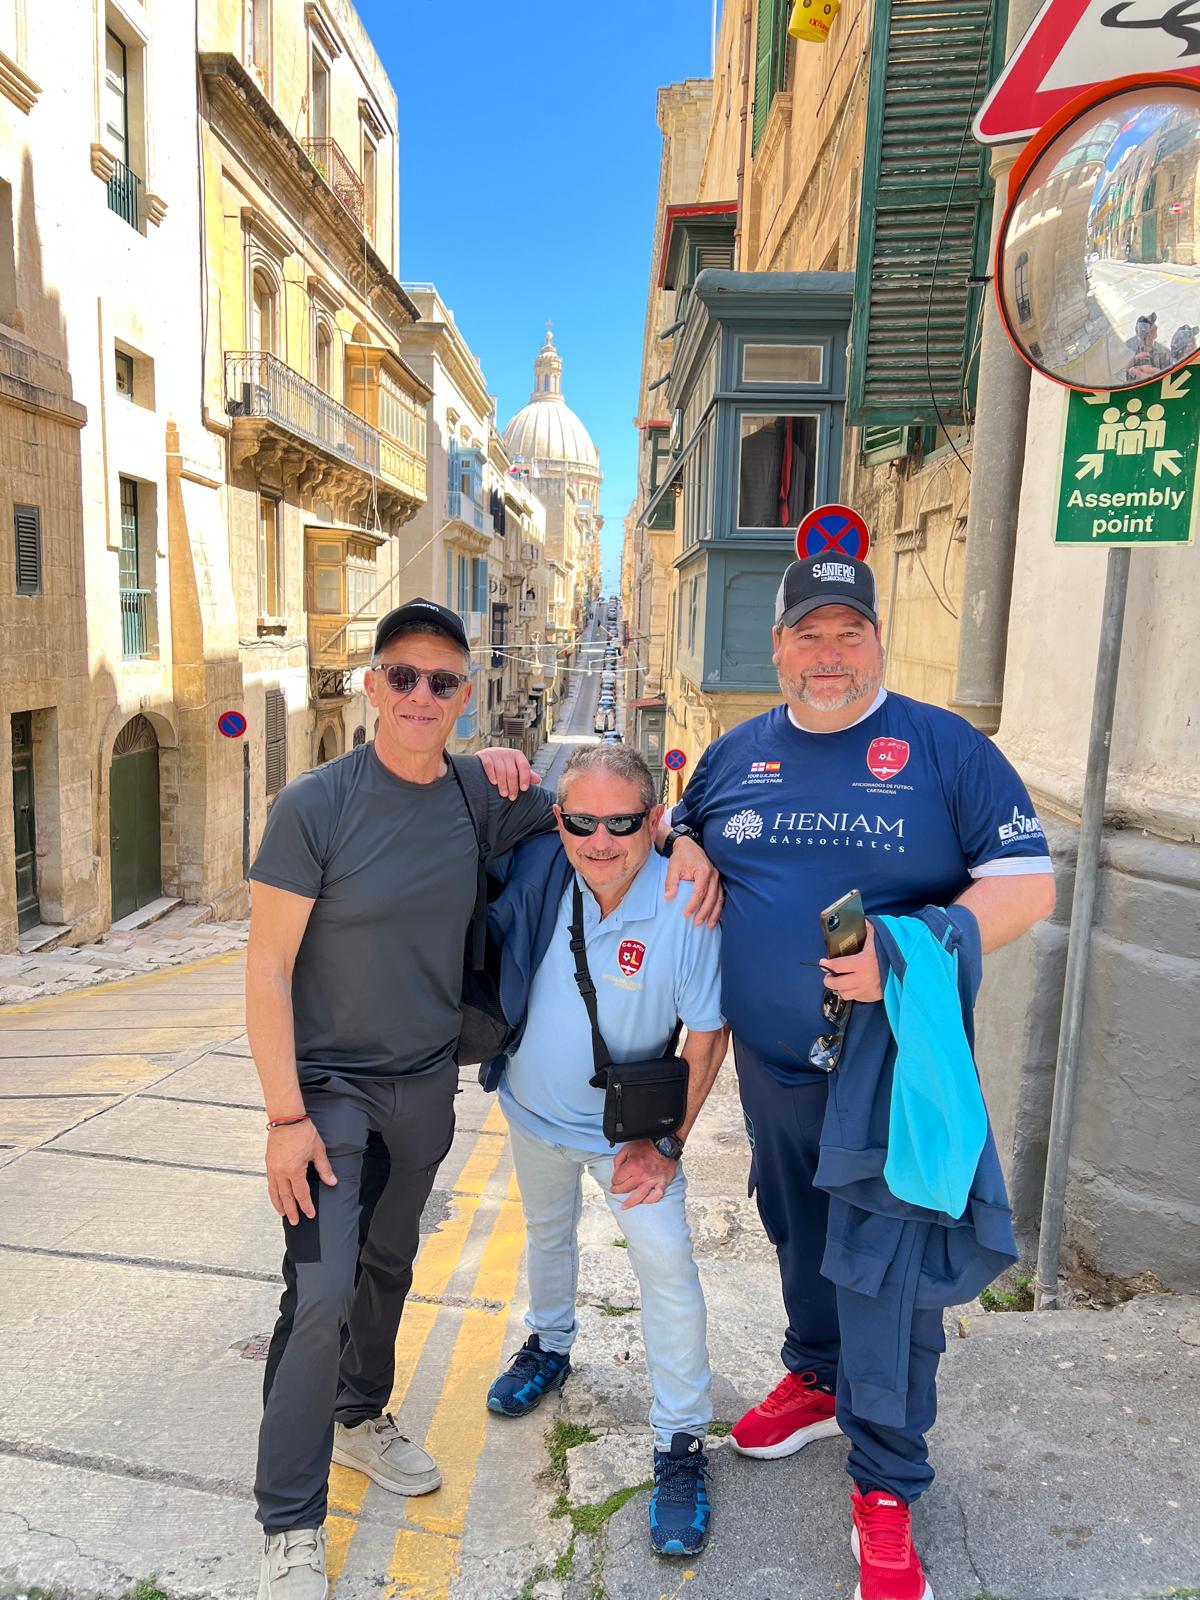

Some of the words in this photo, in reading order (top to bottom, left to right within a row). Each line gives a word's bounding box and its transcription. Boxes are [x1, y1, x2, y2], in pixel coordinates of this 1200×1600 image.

[1066, 487, 1186, 511] Assembly
[1091, 515, 1154, 538] point
[812, 562, 856, 578] SANTERO
[772, 812, 905, 838] HENIAM
